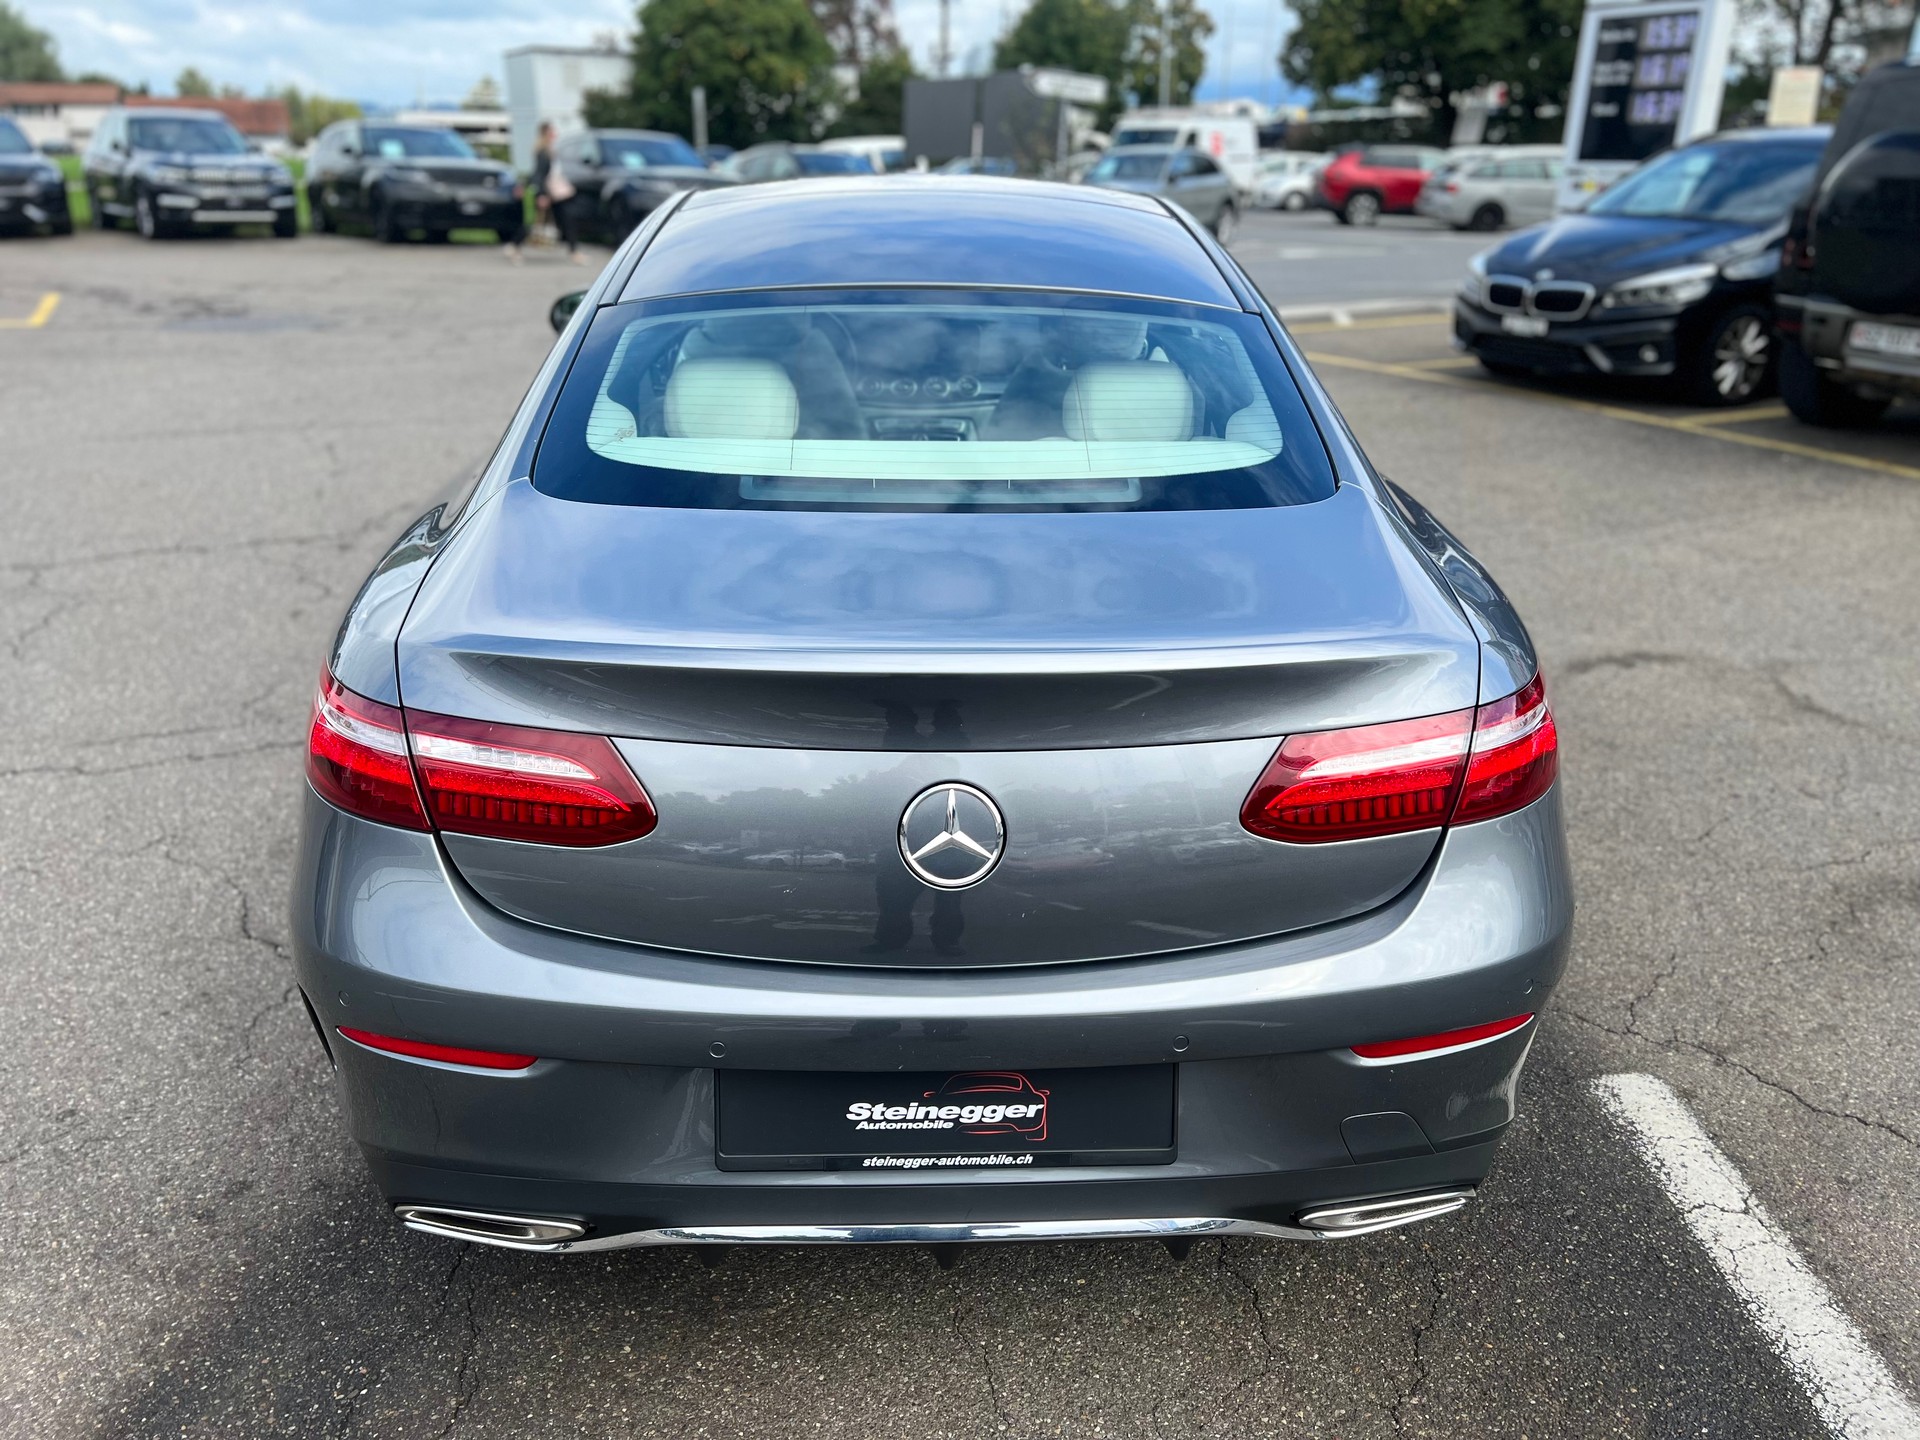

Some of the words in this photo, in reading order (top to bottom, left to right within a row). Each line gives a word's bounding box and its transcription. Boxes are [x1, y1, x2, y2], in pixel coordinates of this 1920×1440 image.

[846, 1102, 1045, 1124] Steinegger
[855, 1120, 954, 1130] Automobile
[862, 1154, 1034, 1169] steinegger-automobile.ch
